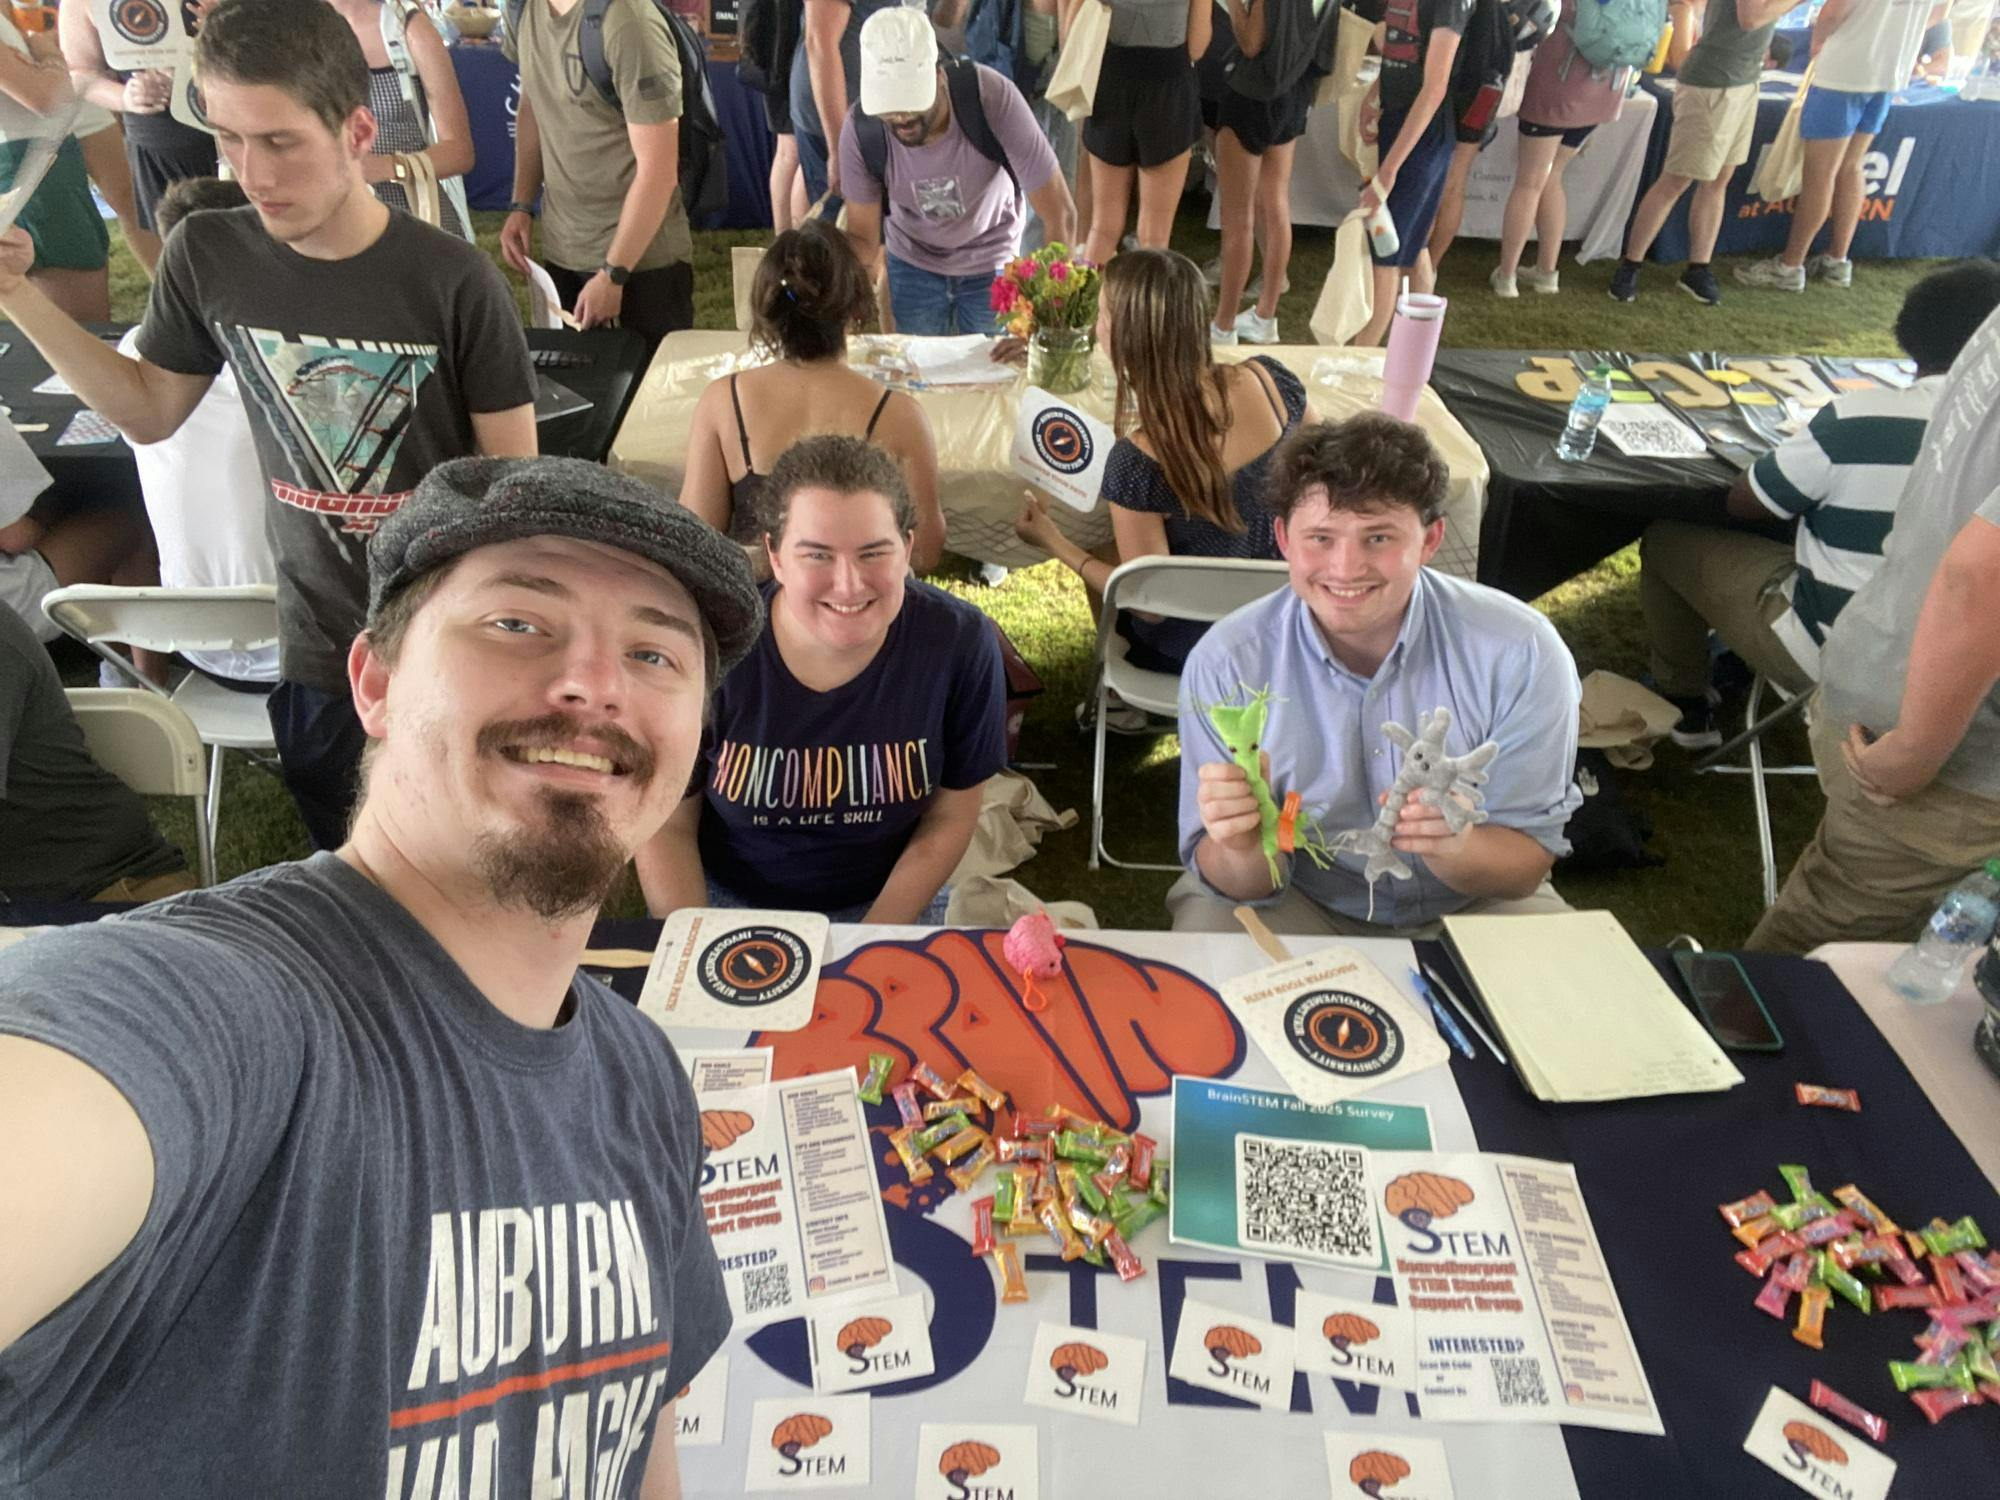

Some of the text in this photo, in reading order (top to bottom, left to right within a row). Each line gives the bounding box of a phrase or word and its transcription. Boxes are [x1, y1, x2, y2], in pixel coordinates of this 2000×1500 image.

[713, 738, 933, 809] NONCOMPLIANCE
[753, 810, 884, 826] IS A LIFE SKILL
[1207, 1088, 1395, 1122] BrainSTEM Fall 2025 Survey
[1398, 1207, 1511, 1257] STEM
[846, 1343, 911, 1374] STEM
[1330, 1335, 1395, 1377] STEM
[1428, 1335, 1526, 1354] INTERESTED?
[1055, 1366, 1118, 1409] STEM
[1208, 1347, 1271, 1395] STEM
[778, 1441, 846, 1476] STEM
